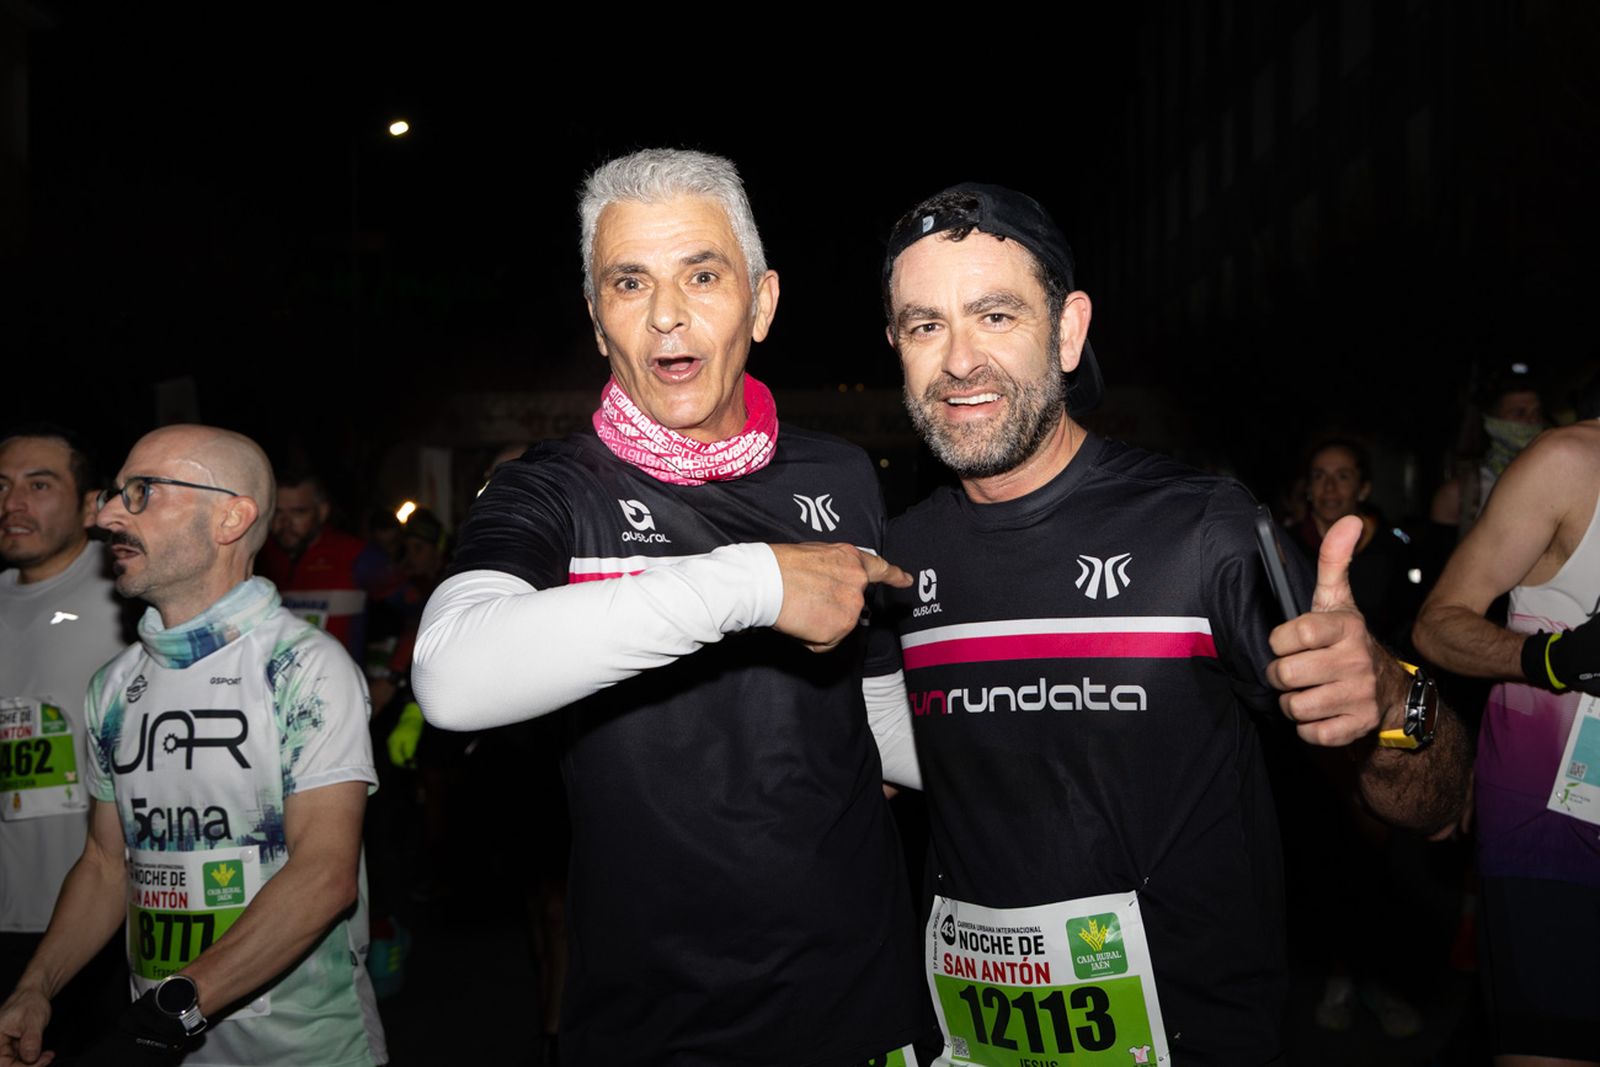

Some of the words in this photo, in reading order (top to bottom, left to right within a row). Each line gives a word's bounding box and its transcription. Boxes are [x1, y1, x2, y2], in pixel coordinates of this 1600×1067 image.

[622, 531, 671, 543] austral
[913, 602, 942, 617] austral
[170, 871, 186, 887] DE
[144, 887, 188, 909] ANTÓN
[941, 921, 955, 938] 43
[957, 920, 976, 930] CARRERA
[977, 924, 995, 933] URBANA
[995, 925, 1042, 934] INTERNACIONAL
[139, 911, 215, 962] 8777
[959, 929, 1015, 956] NOCHE
[1018, 935, 1046, 956] DE
[1076, 954, 1096, 965] CAJA
[1096, 950, 1122, 961] RURAL
[944, 952, 977, 979] SAN
[981, 957, 1050, 985] ANTÓN
[959, 985, 1117, 1054] 12113
